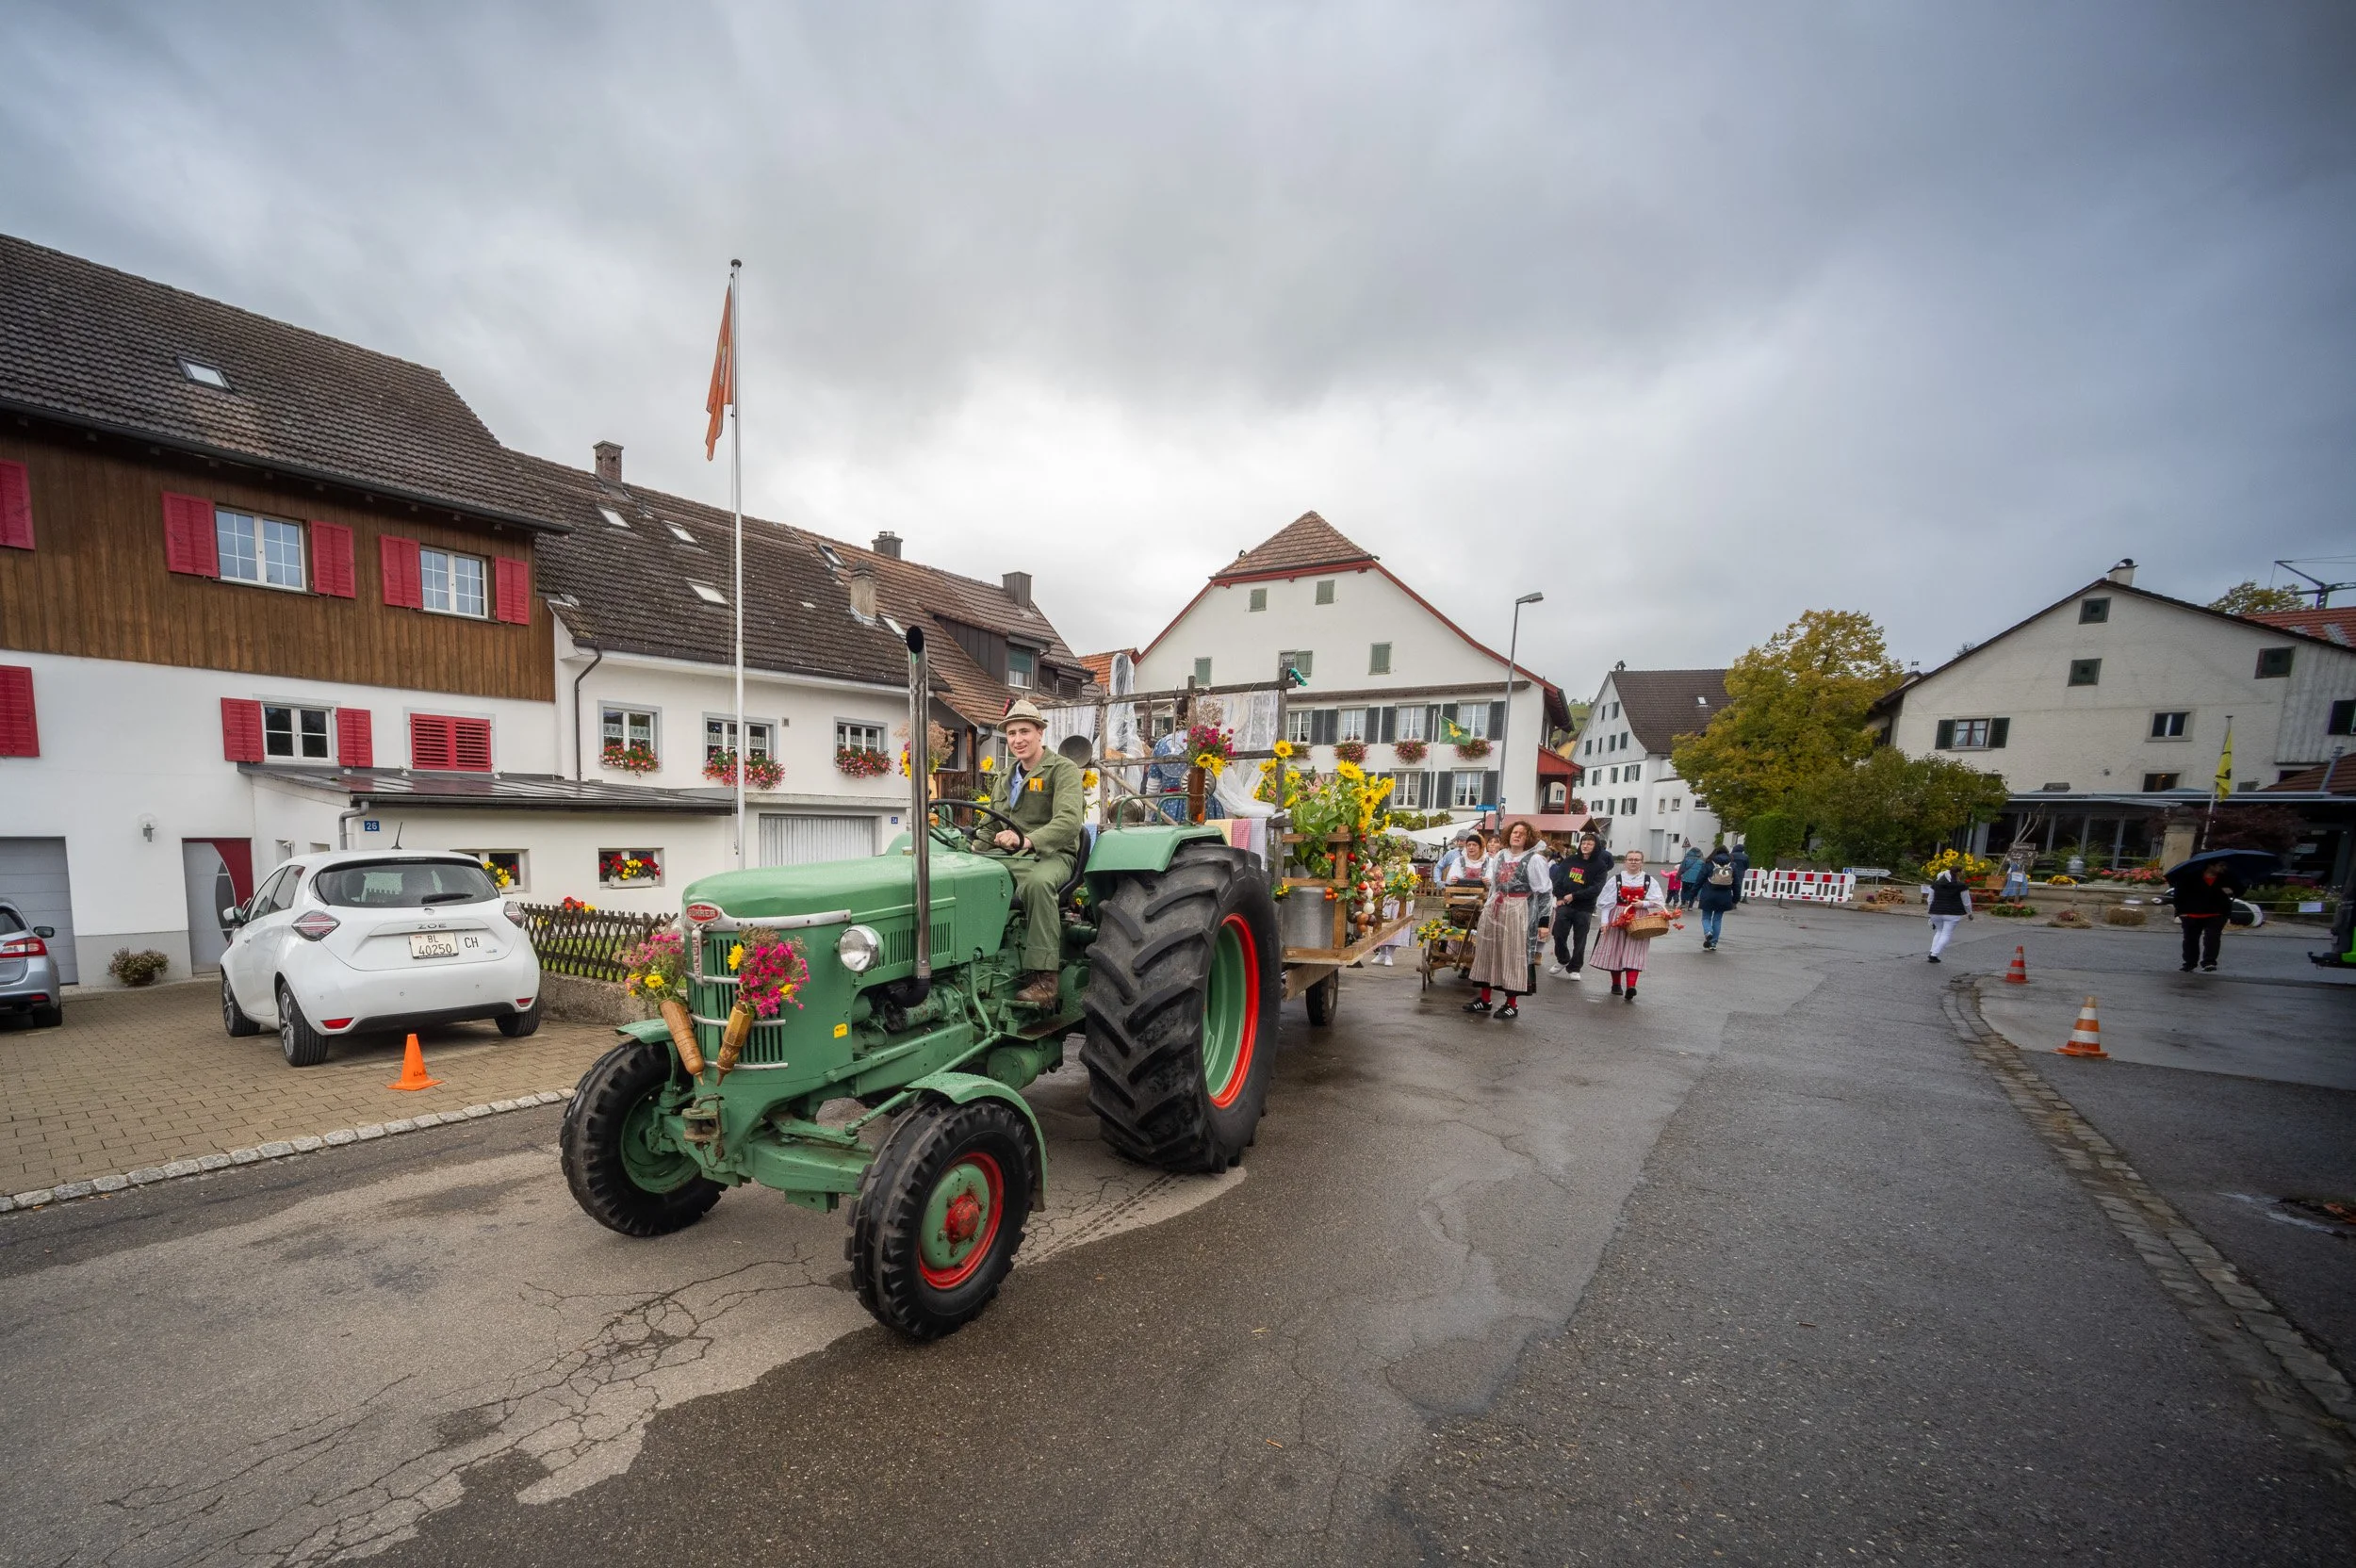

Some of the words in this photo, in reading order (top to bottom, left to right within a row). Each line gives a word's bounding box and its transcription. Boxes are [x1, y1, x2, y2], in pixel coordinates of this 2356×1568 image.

[367, 822, 378, 830] 26
[427, 935, 439, 943] BL
[464, 937, 479, 949] CH
[418, 943, 452, 956] 40250
